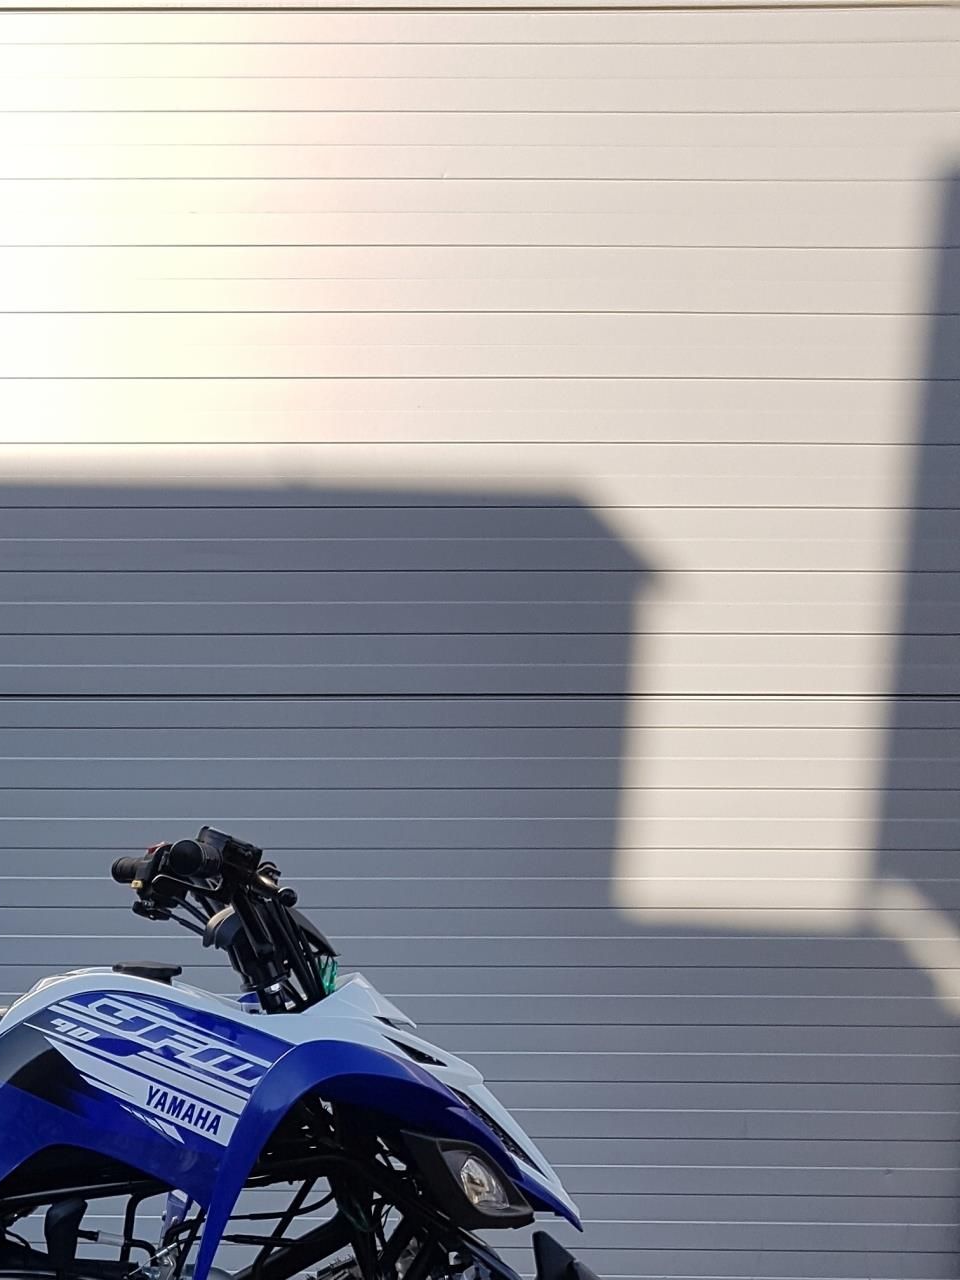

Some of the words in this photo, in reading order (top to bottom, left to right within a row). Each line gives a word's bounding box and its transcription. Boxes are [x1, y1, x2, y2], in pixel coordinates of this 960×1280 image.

[49, 1018, 101, 1042] 90
[88, 997, 262, 1088] YFM
[145, 1085, 222, 1136] YAMAHA
